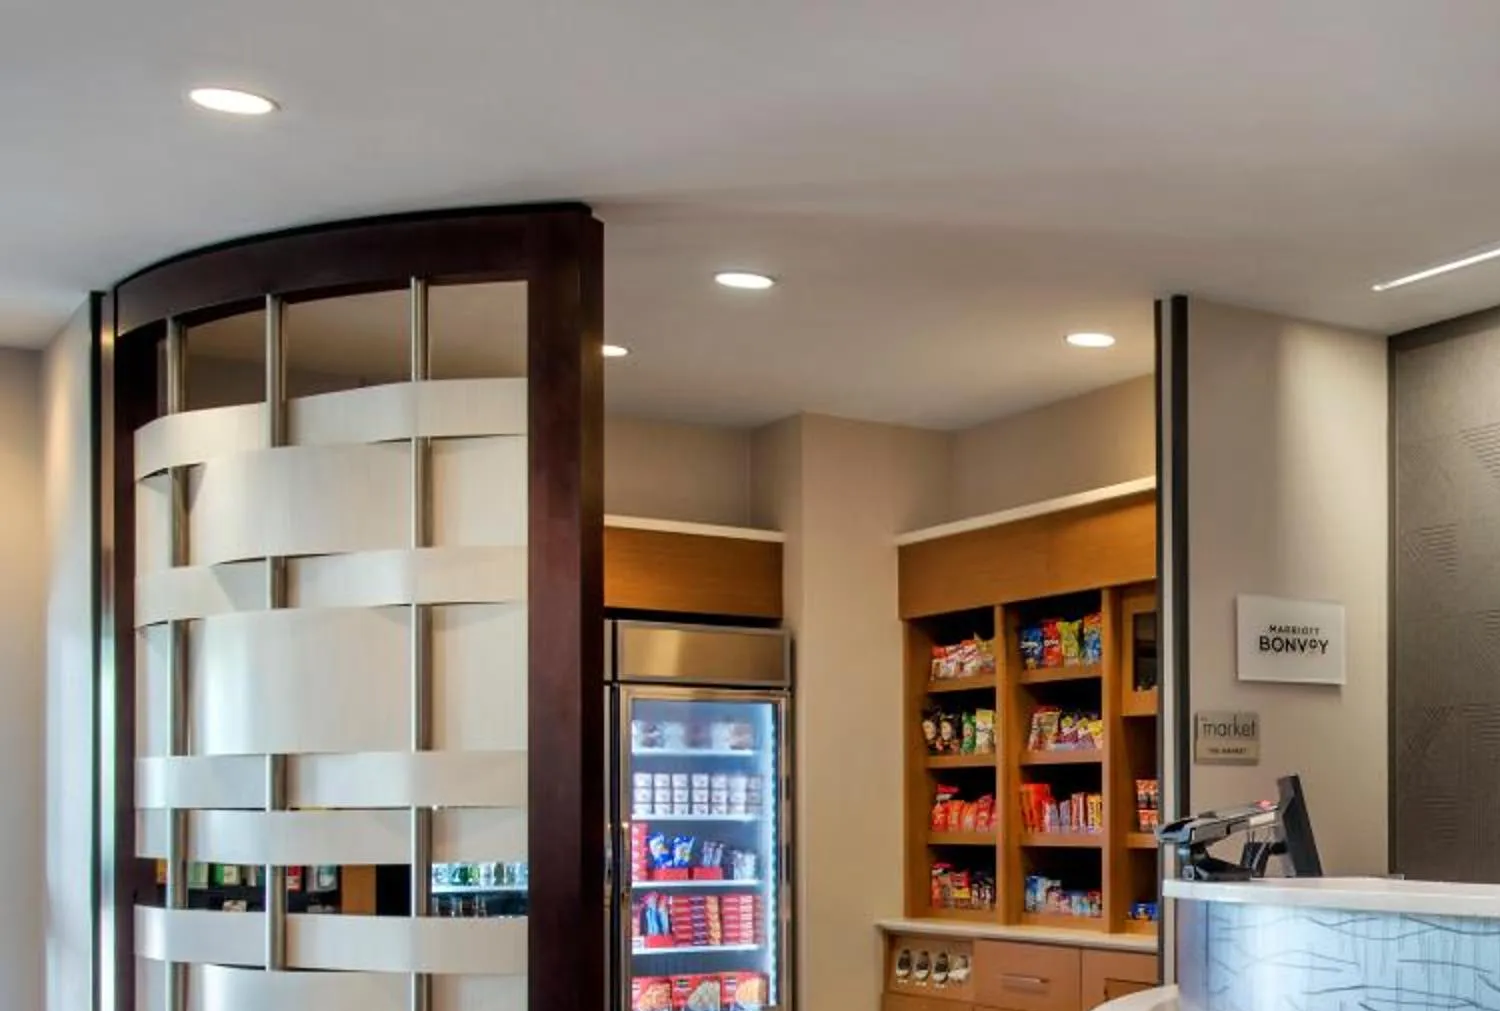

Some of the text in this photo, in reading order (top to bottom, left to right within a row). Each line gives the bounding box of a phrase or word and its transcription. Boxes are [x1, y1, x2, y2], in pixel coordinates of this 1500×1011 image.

[1268, 624, 1320, 635] MARRIOTT
[1259, 635, 1329, 655] BONVOY
[1202, 714, 1255, 737] market
